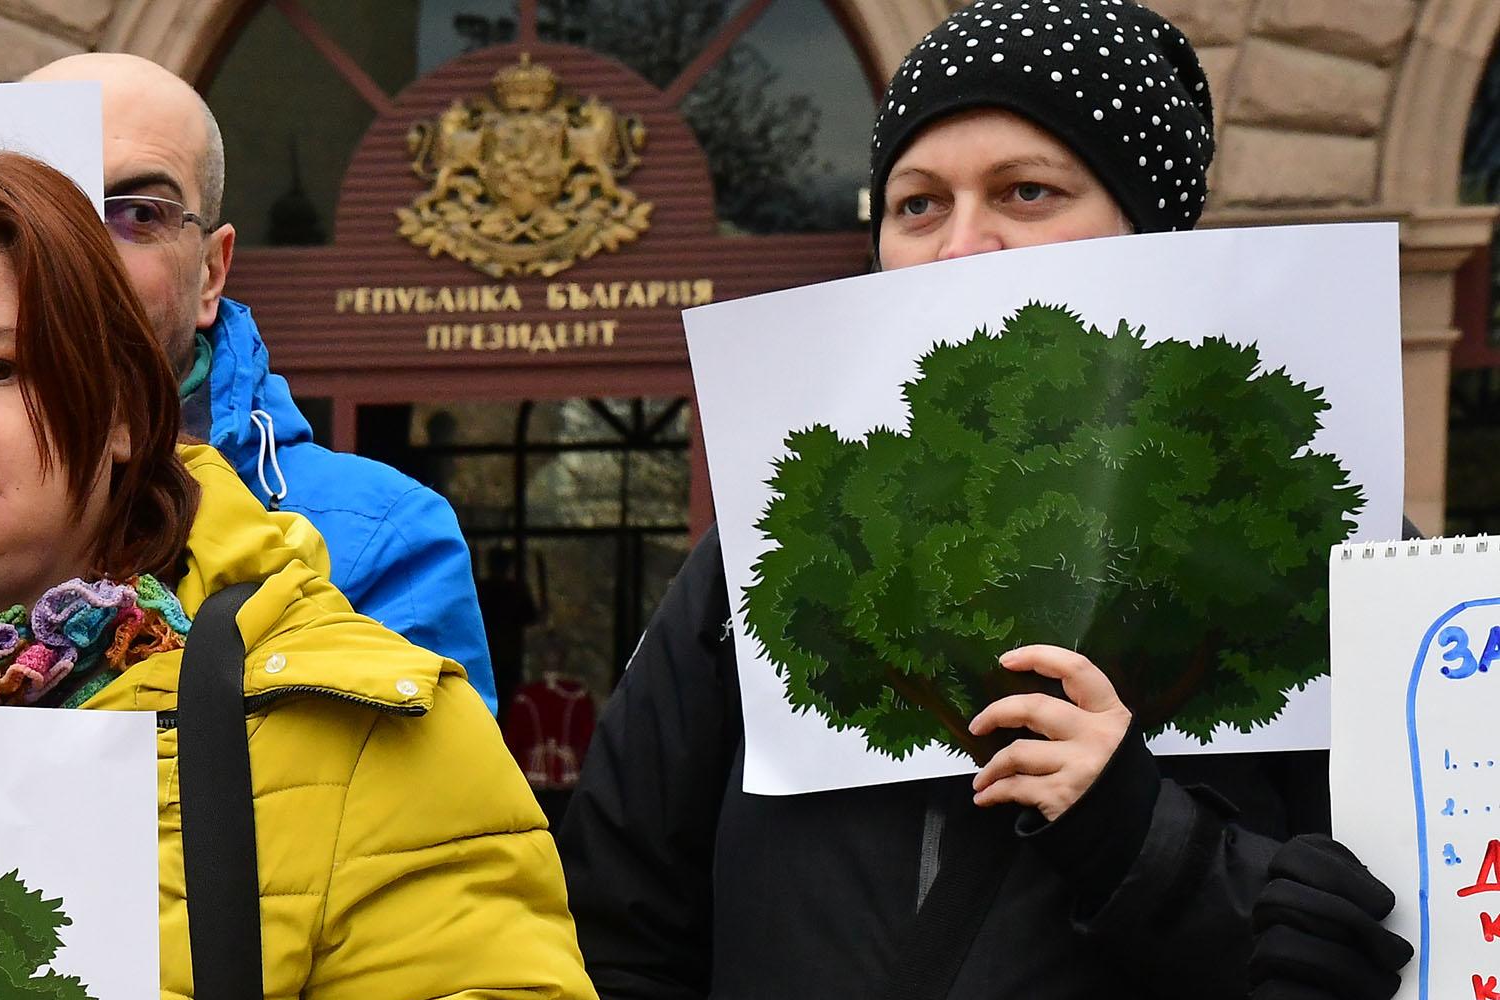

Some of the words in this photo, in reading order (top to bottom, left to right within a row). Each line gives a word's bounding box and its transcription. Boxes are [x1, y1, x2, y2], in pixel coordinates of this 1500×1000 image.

[335, 285, 522, 314] РЕПУБЛИКА
[546, 279, 714, 310] БЪЛГАРИЯ
[426, 320, 619, 352] ПРЕЗИДЕНТ
